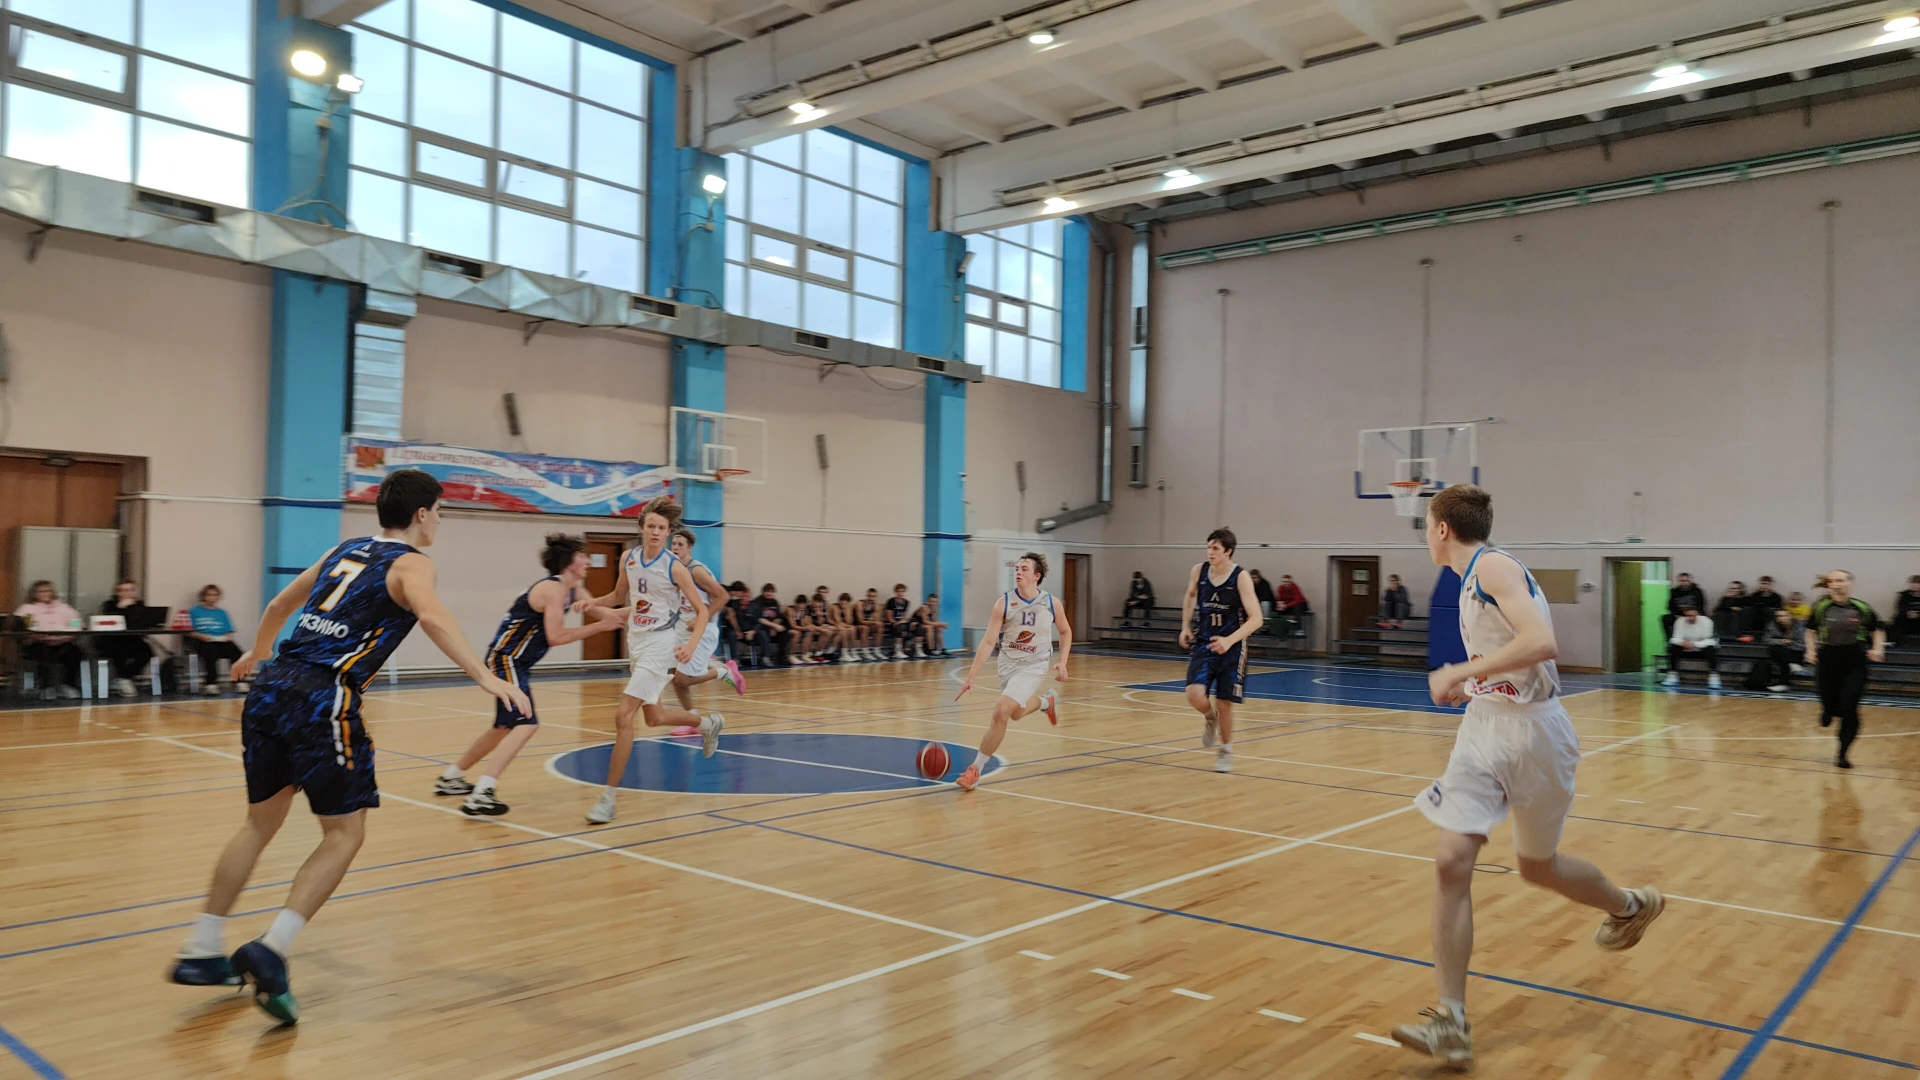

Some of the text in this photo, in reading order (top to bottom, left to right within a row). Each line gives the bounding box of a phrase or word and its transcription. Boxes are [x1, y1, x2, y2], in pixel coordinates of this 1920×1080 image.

[318, 558, 367, 612] 7
[638, 577, 647, 594] 8
[1020, 611, 1036, 626] 13
[1210, 613, 1223, 627] 11
